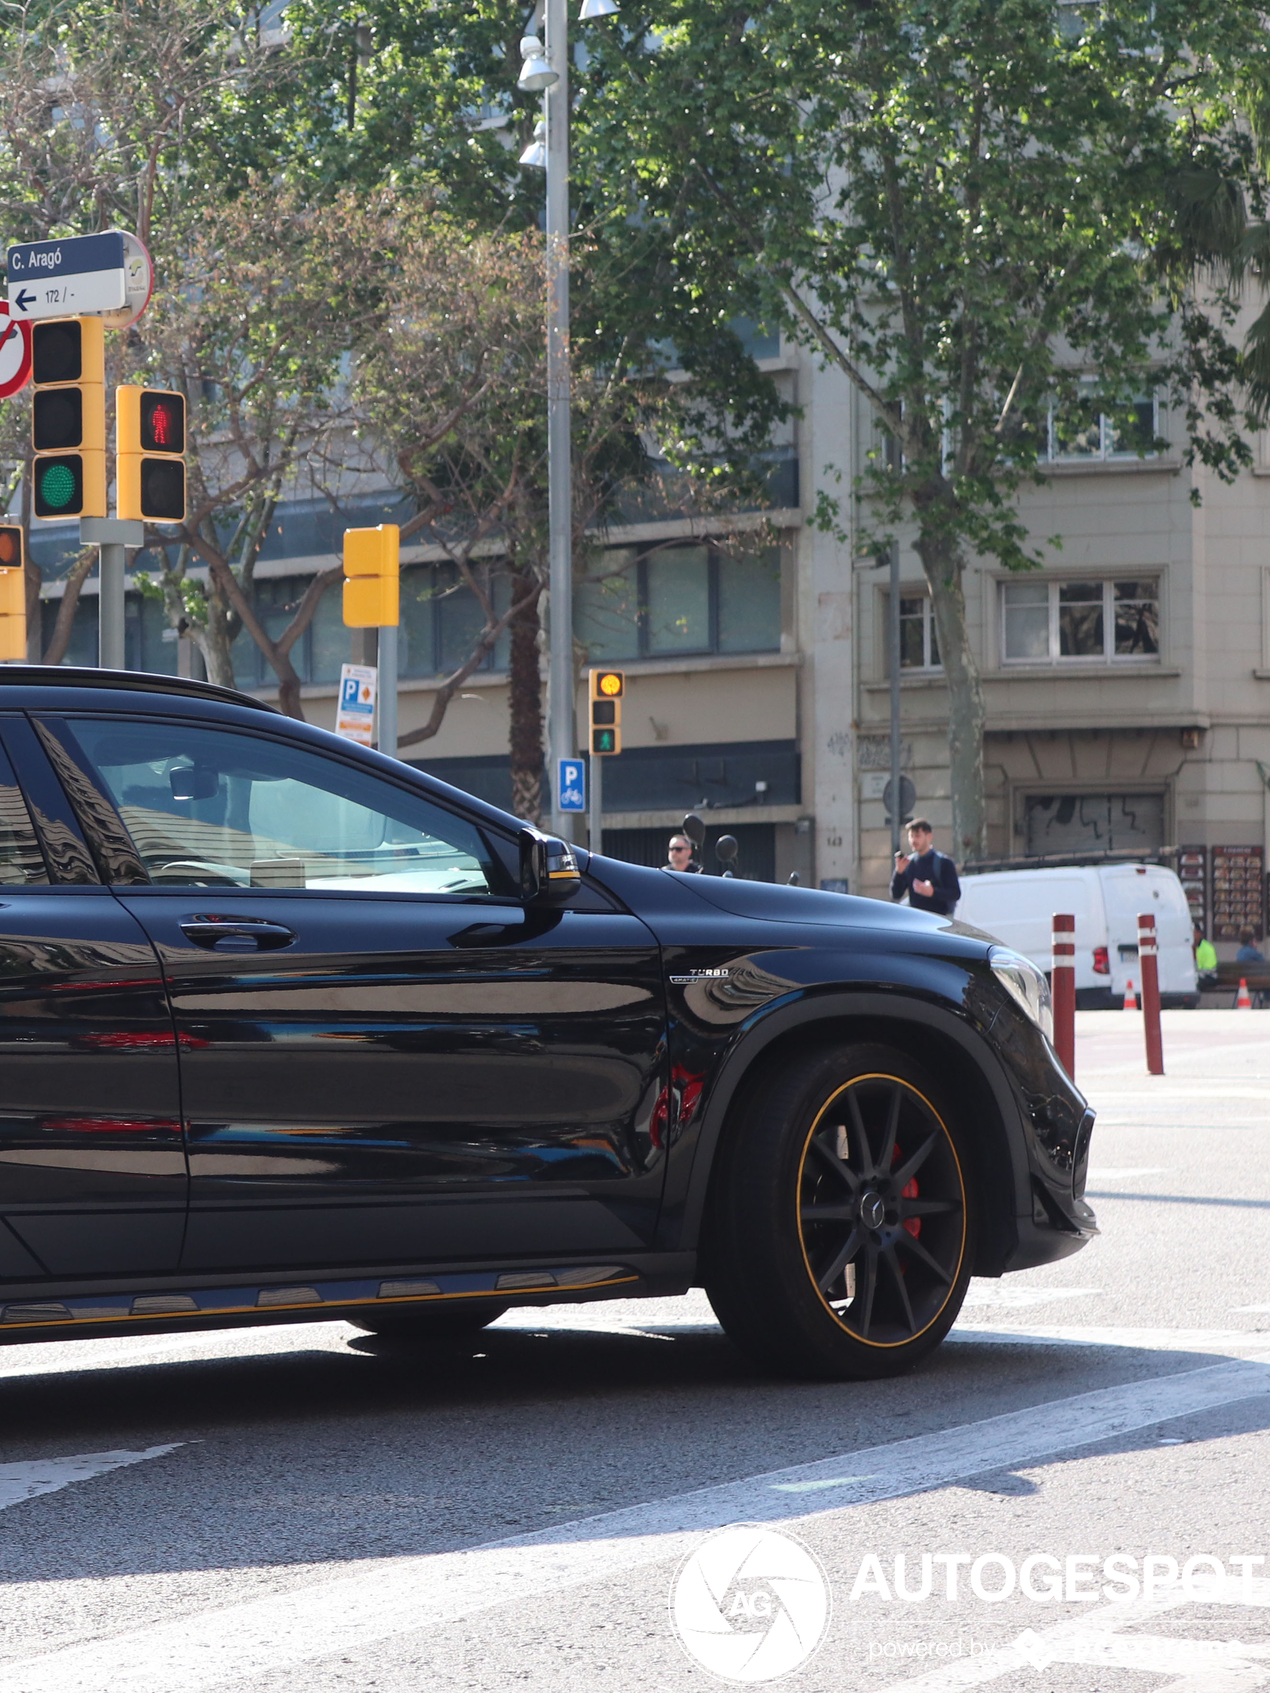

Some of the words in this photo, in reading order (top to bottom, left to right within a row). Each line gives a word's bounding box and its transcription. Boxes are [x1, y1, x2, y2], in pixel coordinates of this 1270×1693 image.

[12, 253, 25, 270] C.
[28, 247, 62, 270] Aragó
[45, 289, 60, 303] 172
[345, 680, 357, 700] P
[565, 766, 578, 786] P
[690, 968, 729, 976] TURBO
